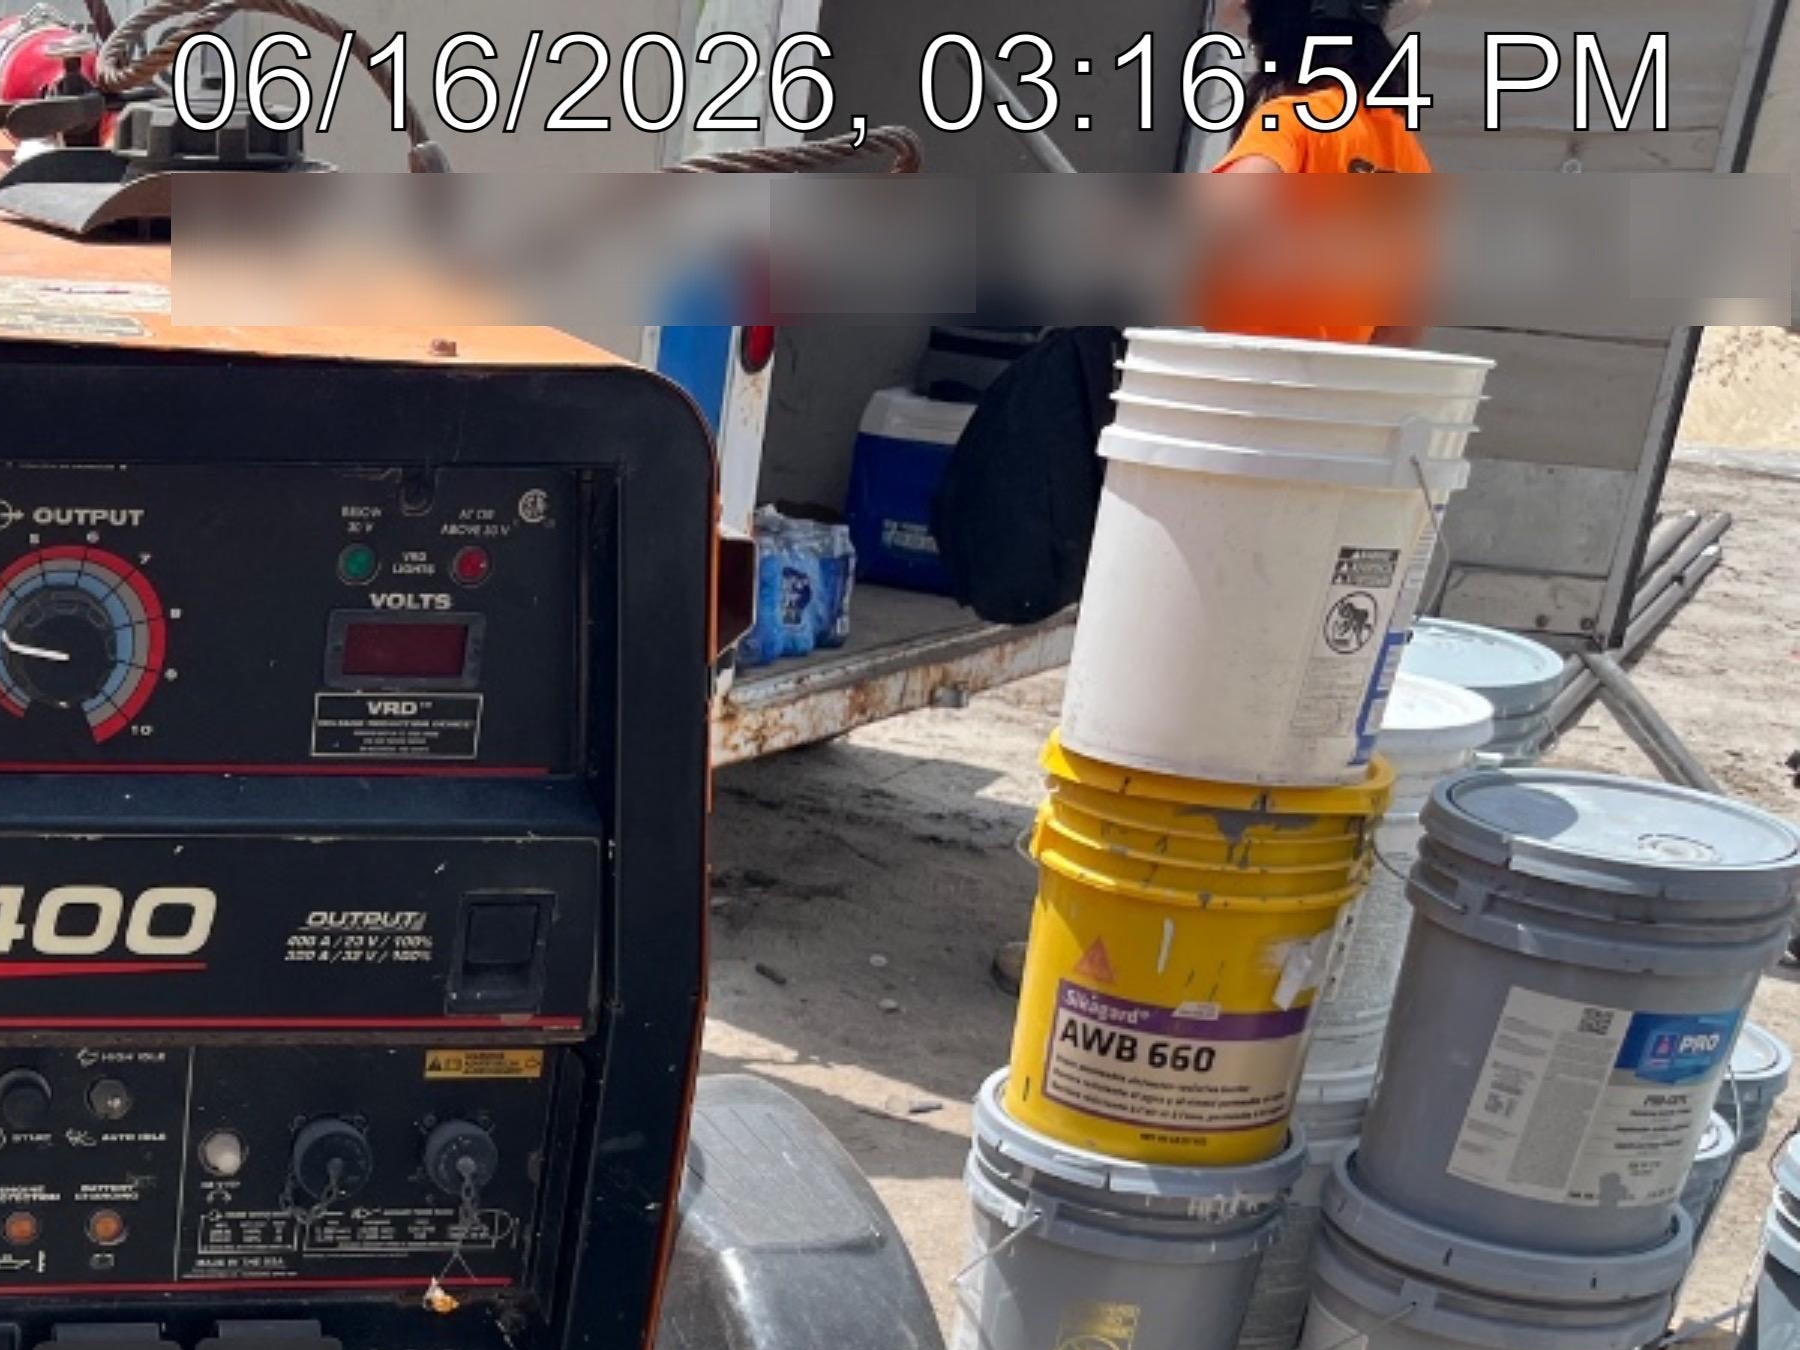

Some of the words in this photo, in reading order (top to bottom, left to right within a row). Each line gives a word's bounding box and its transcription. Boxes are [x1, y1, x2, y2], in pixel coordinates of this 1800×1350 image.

[32, 508, 144, 526] OUTPUT
[140, 553, 151, 564] 7
[369, 592, 451, 610] VOLTS
[131, 724, 152, 736] 10
[306, 911, 419, 928] OUTPUT
[1060, 1019, 1138, 1062] AWB
[1148, 1042, 1216, 1073] 660
[1679, 1033, 1721, 1055] PRO
